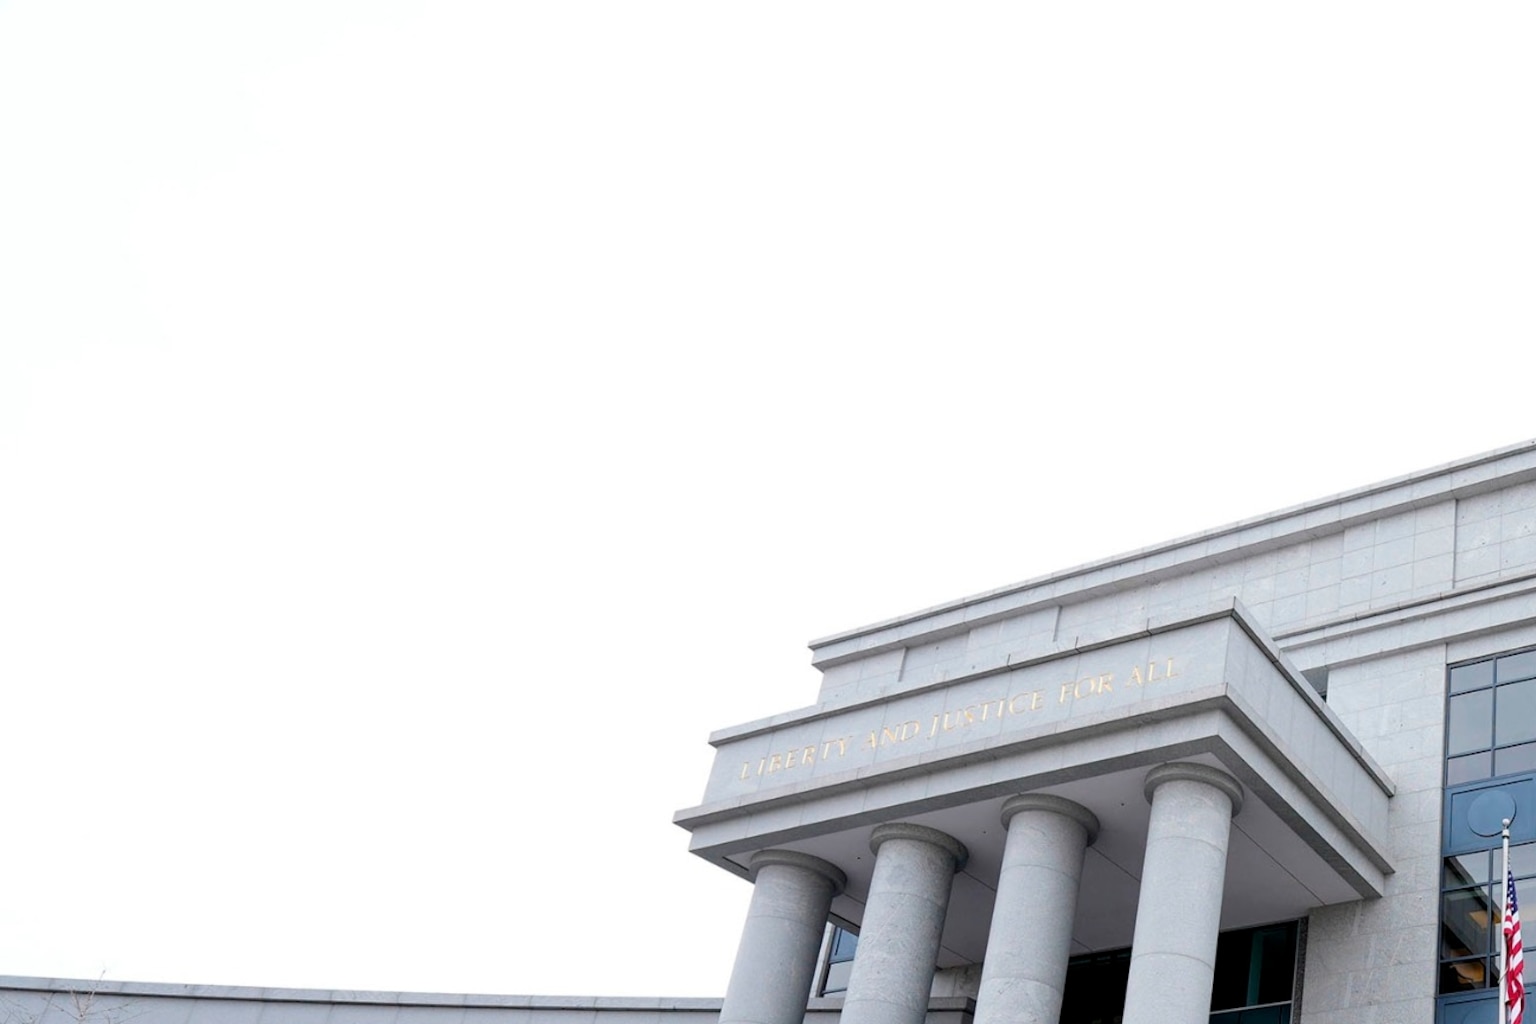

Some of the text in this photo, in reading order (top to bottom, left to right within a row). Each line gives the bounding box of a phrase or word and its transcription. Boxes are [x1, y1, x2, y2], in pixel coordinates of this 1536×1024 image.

[741, 657, 1181, 780] LIBERTY AND JUSTICE FOR ALL
